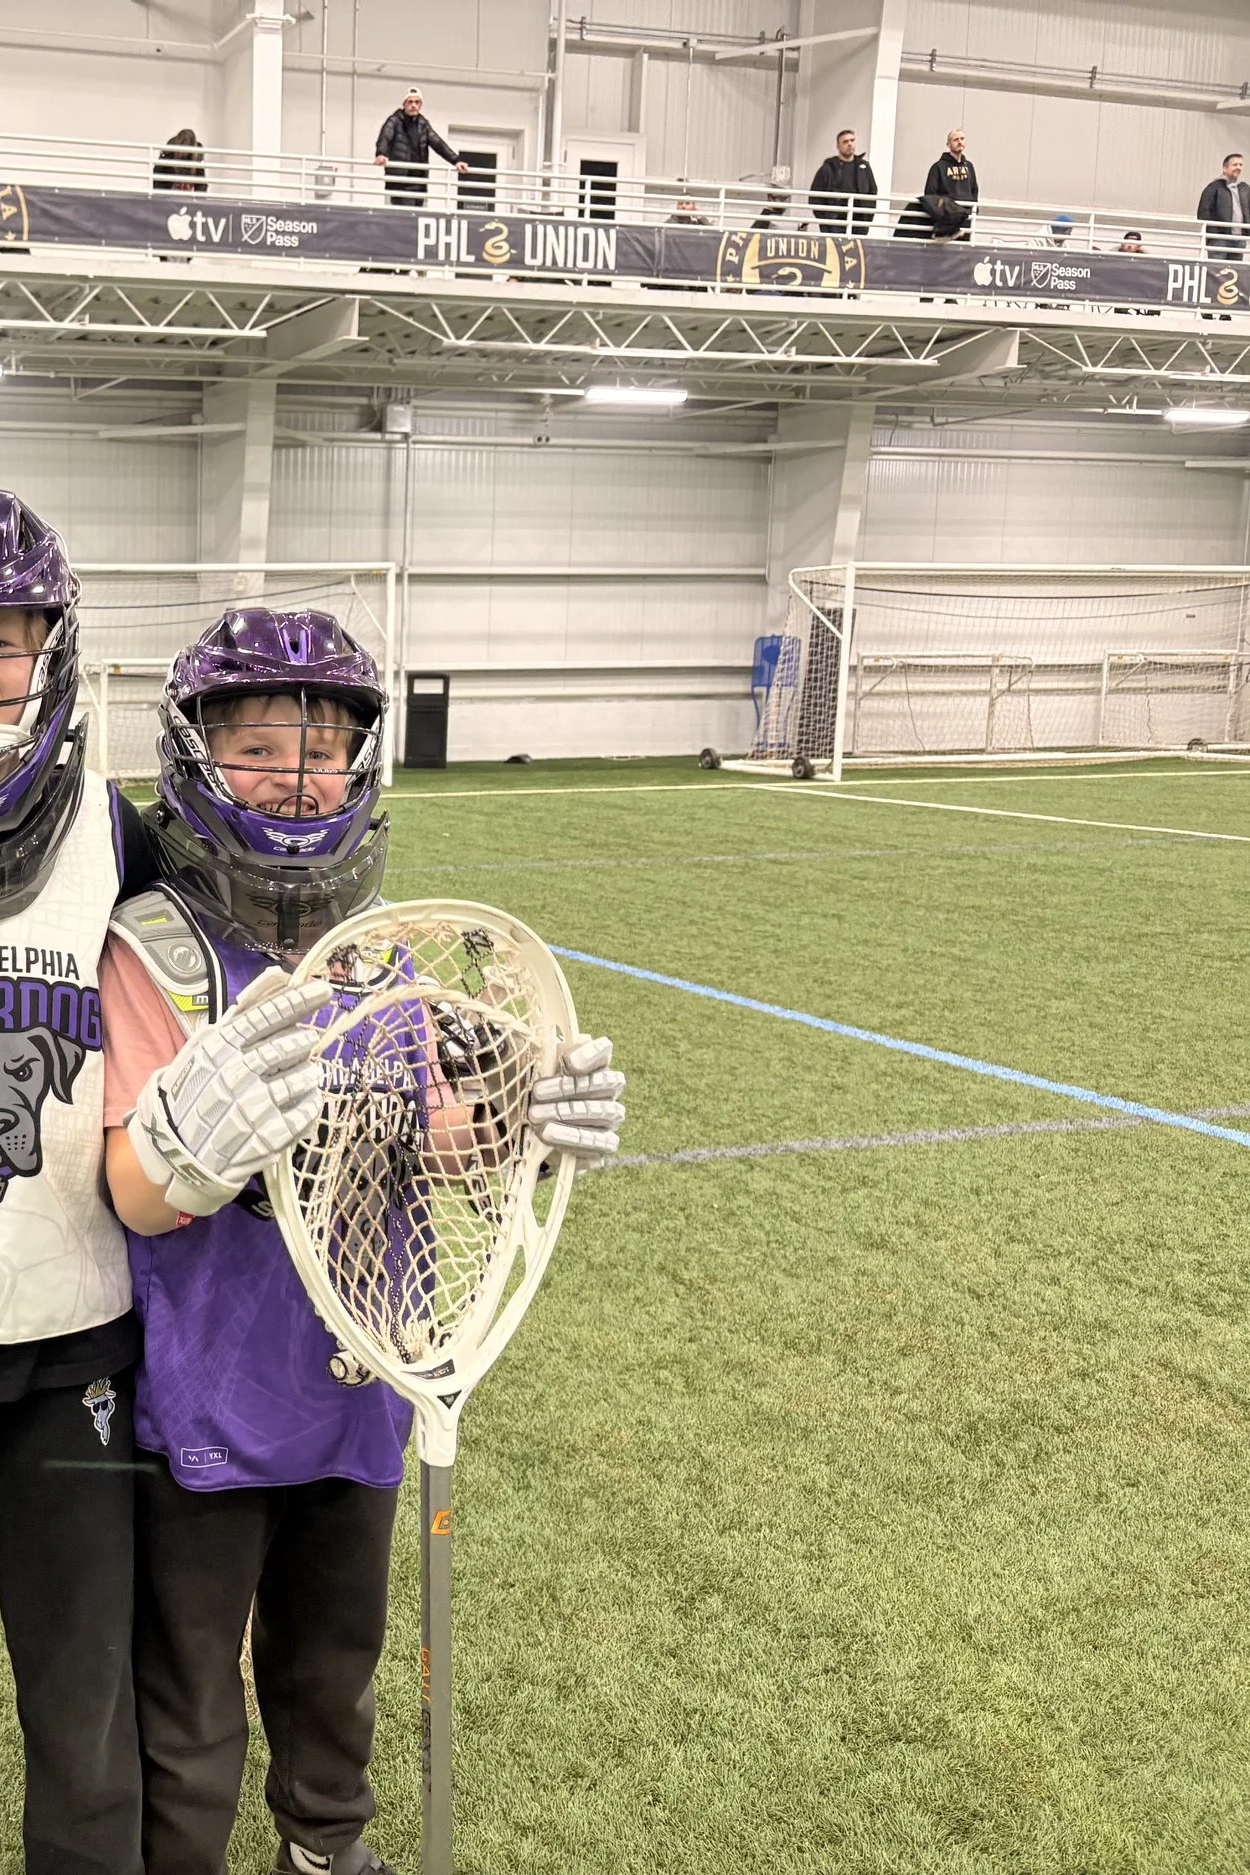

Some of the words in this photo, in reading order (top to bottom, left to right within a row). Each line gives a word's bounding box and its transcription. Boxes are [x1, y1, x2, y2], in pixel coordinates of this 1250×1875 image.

[267, 216, 317, 234] Season
[267, 232, 299, 247] Pass
[417, 217, 476, 264] PHL
[524, 224, 617, 271] UNION
[766, 238, 819, 260] UNION
[1051, 263, 1090, 278] Season
[1051, 277, 1076, 290] Pass
[1167, 263, 1212, 304] PHL
[209, 1452, 223, 1460] YXL
